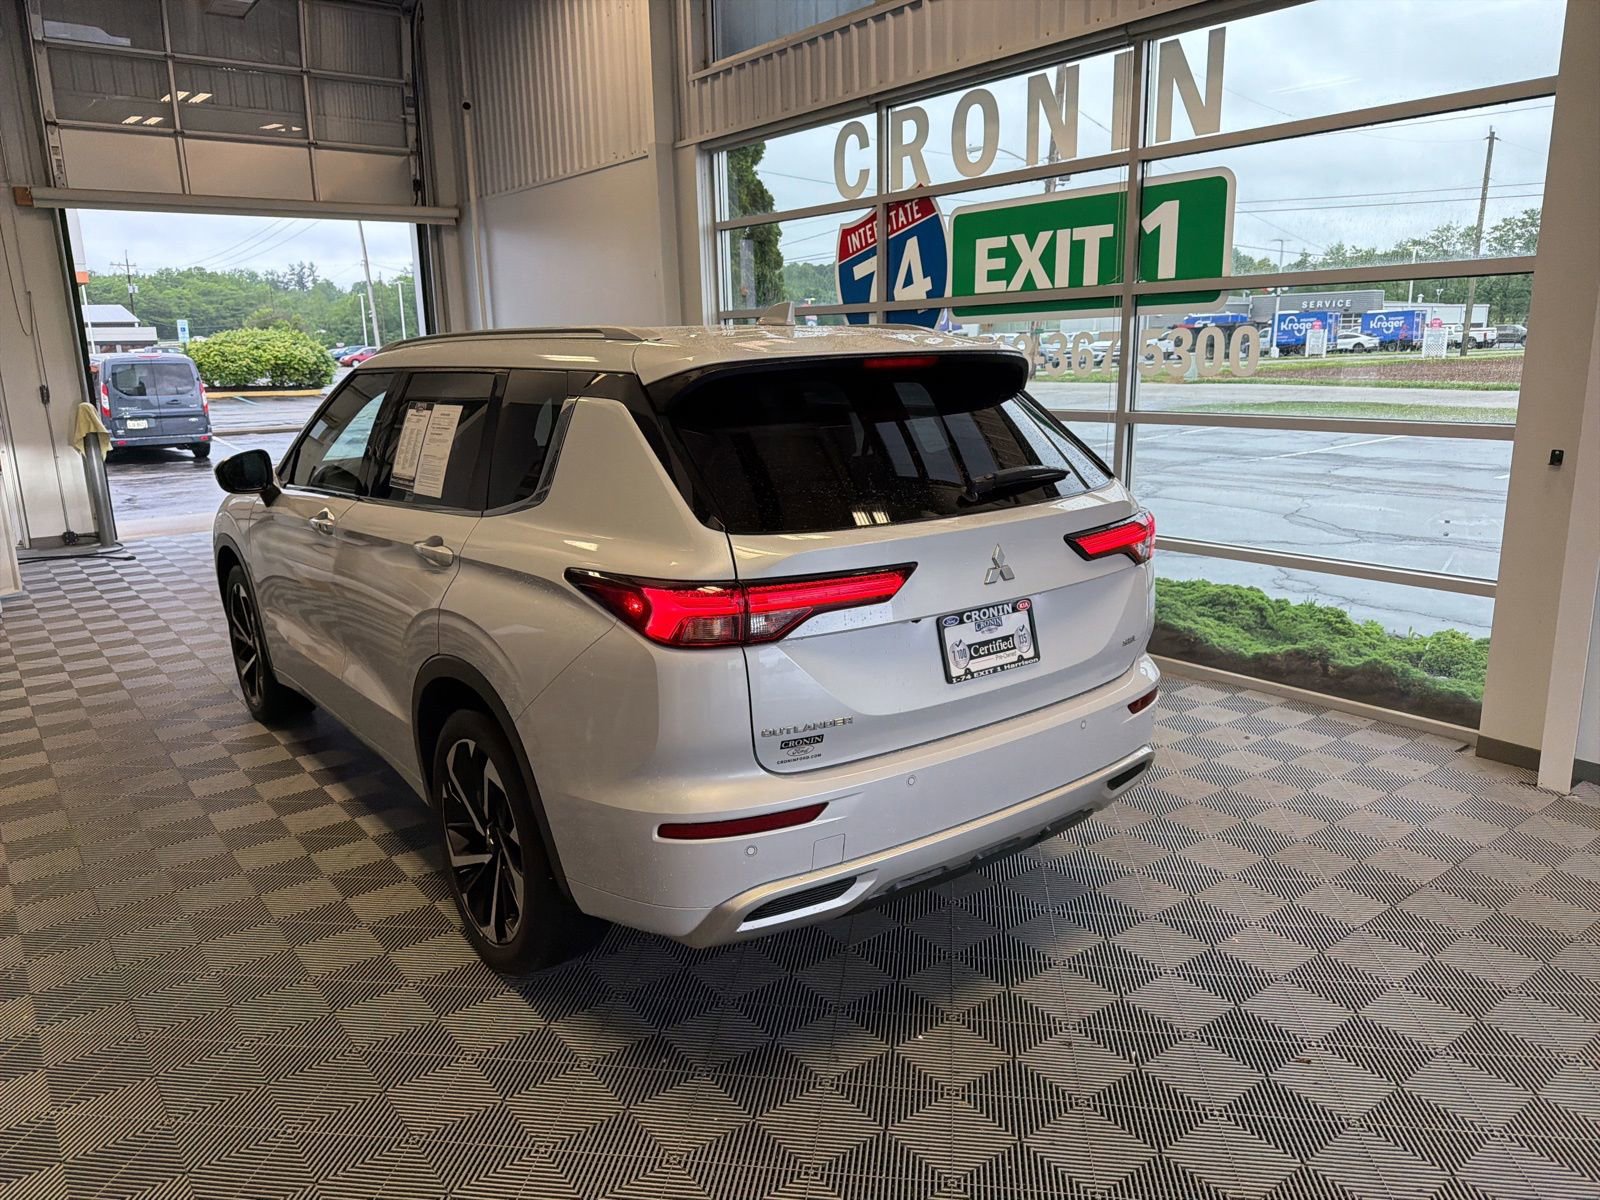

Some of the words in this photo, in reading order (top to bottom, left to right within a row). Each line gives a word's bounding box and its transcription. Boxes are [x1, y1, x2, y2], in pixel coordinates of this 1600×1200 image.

[834, 27, 1226, 199] CRONIN
[974, 223, 1114, 294] EXIT
[1141, 200, 1180, 280] 1
[853, 236, 933, 324] 74
[1301, 299, 1352, 309] SERVICE
[1370, 315, 1405, 334] Kroger
[963, 603, 1013, 622] CRONIN
[970, 637, 1014, 657] Certified
[952, 673, 972, 684] I-74
[973, 668, 994, 678] EXIT
[1004, 658, 1039, 670] Harrison
[761, 716, 854, 738] OUTLANDER
[781, 736, 823, 749] CRONIN
[776, 753, 822, 765] CRONINFORD.COM
